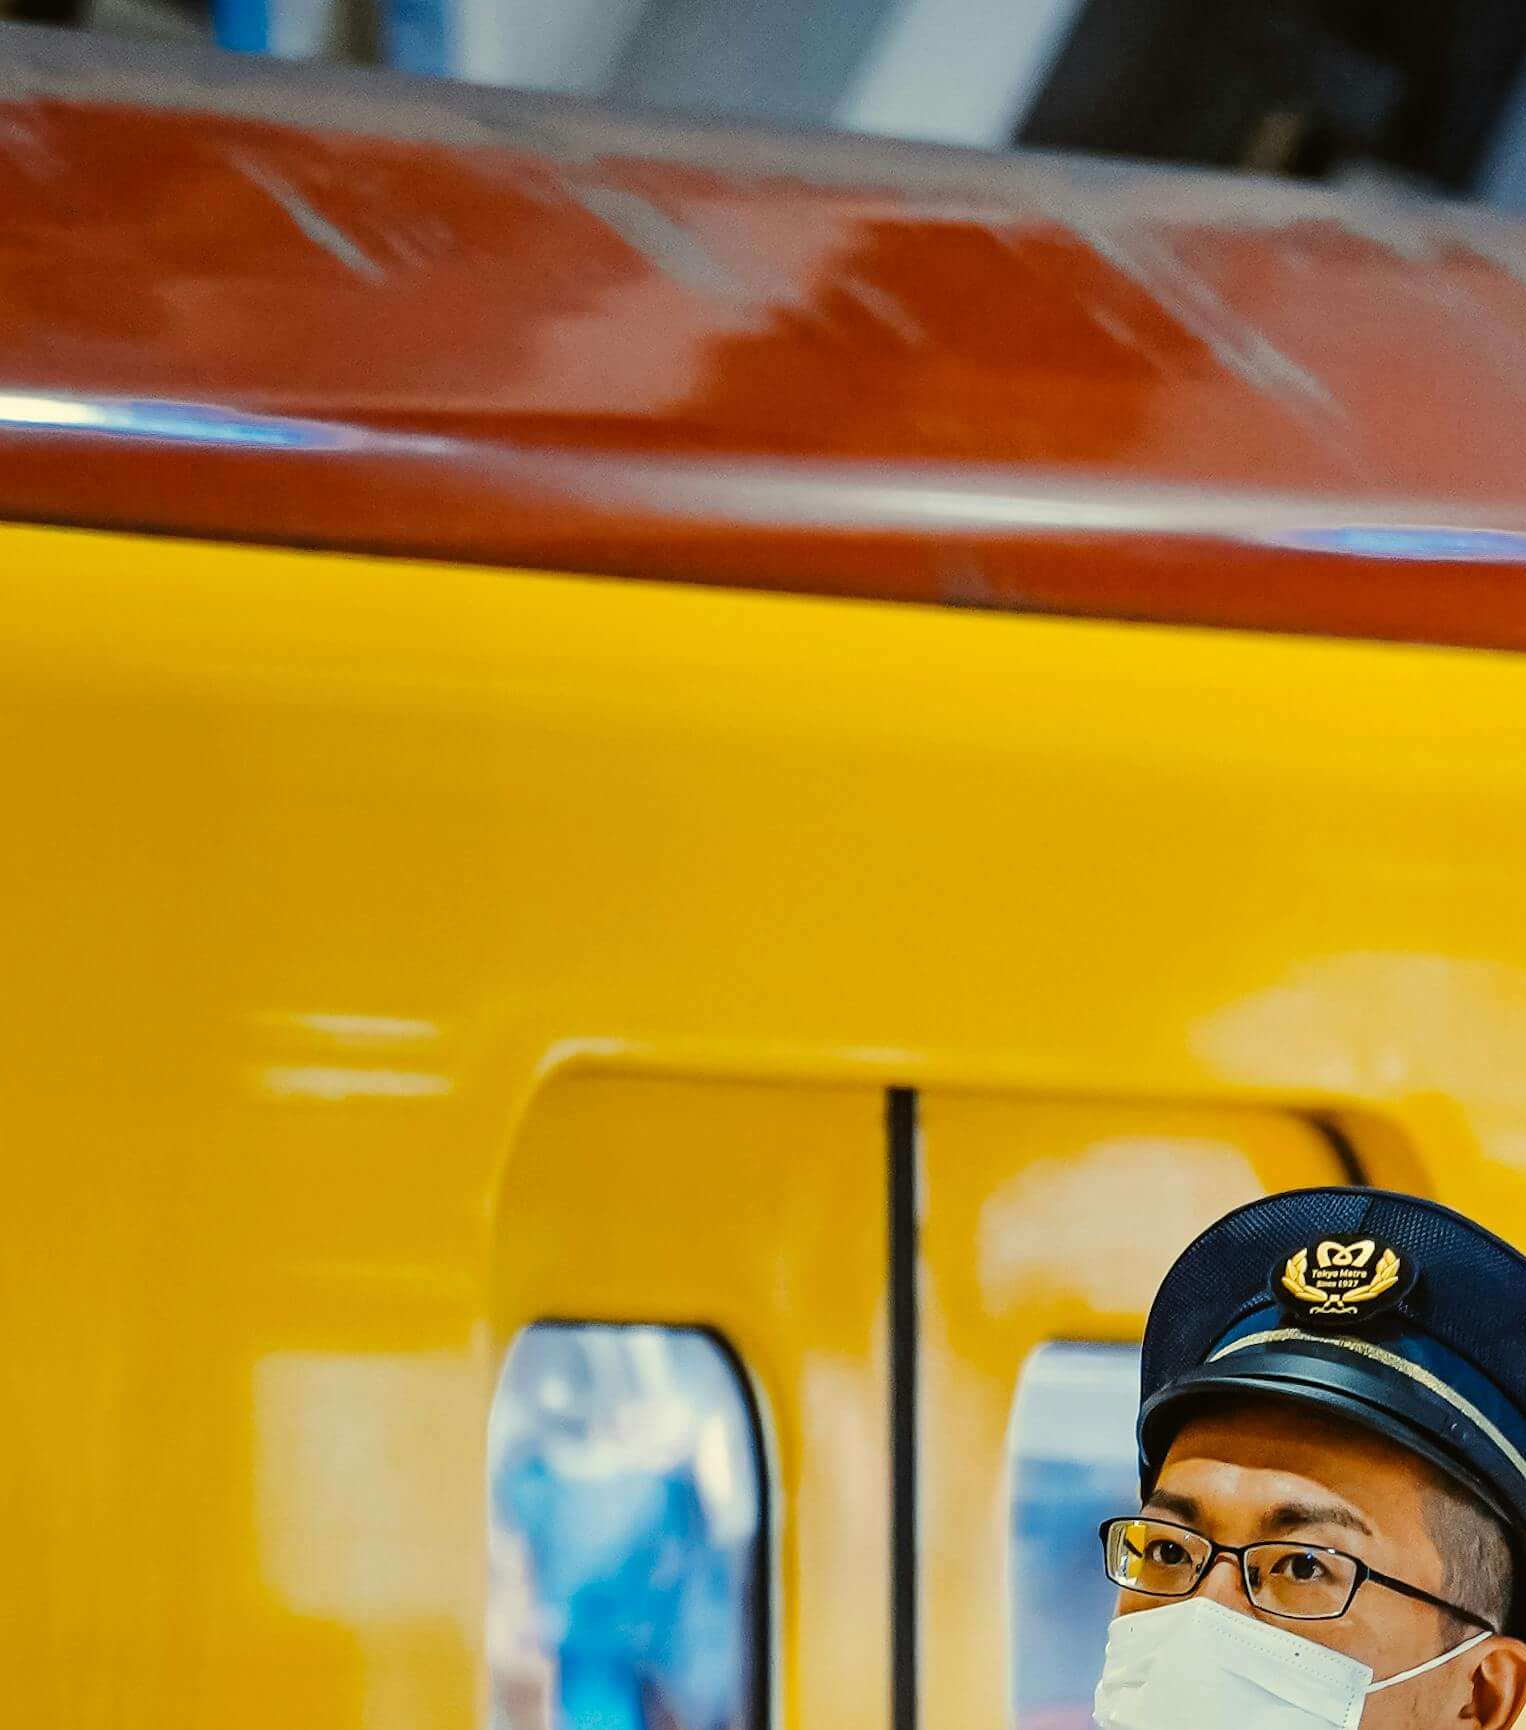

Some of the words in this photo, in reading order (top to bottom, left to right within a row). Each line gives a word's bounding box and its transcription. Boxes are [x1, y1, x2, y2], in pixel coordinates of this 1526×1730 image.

[1311, 1269, 1338, 1279] Tokyo
[1339, 1269, 1367, 1279] Metro
[1338, 1280, 1359, 1288] 1927
